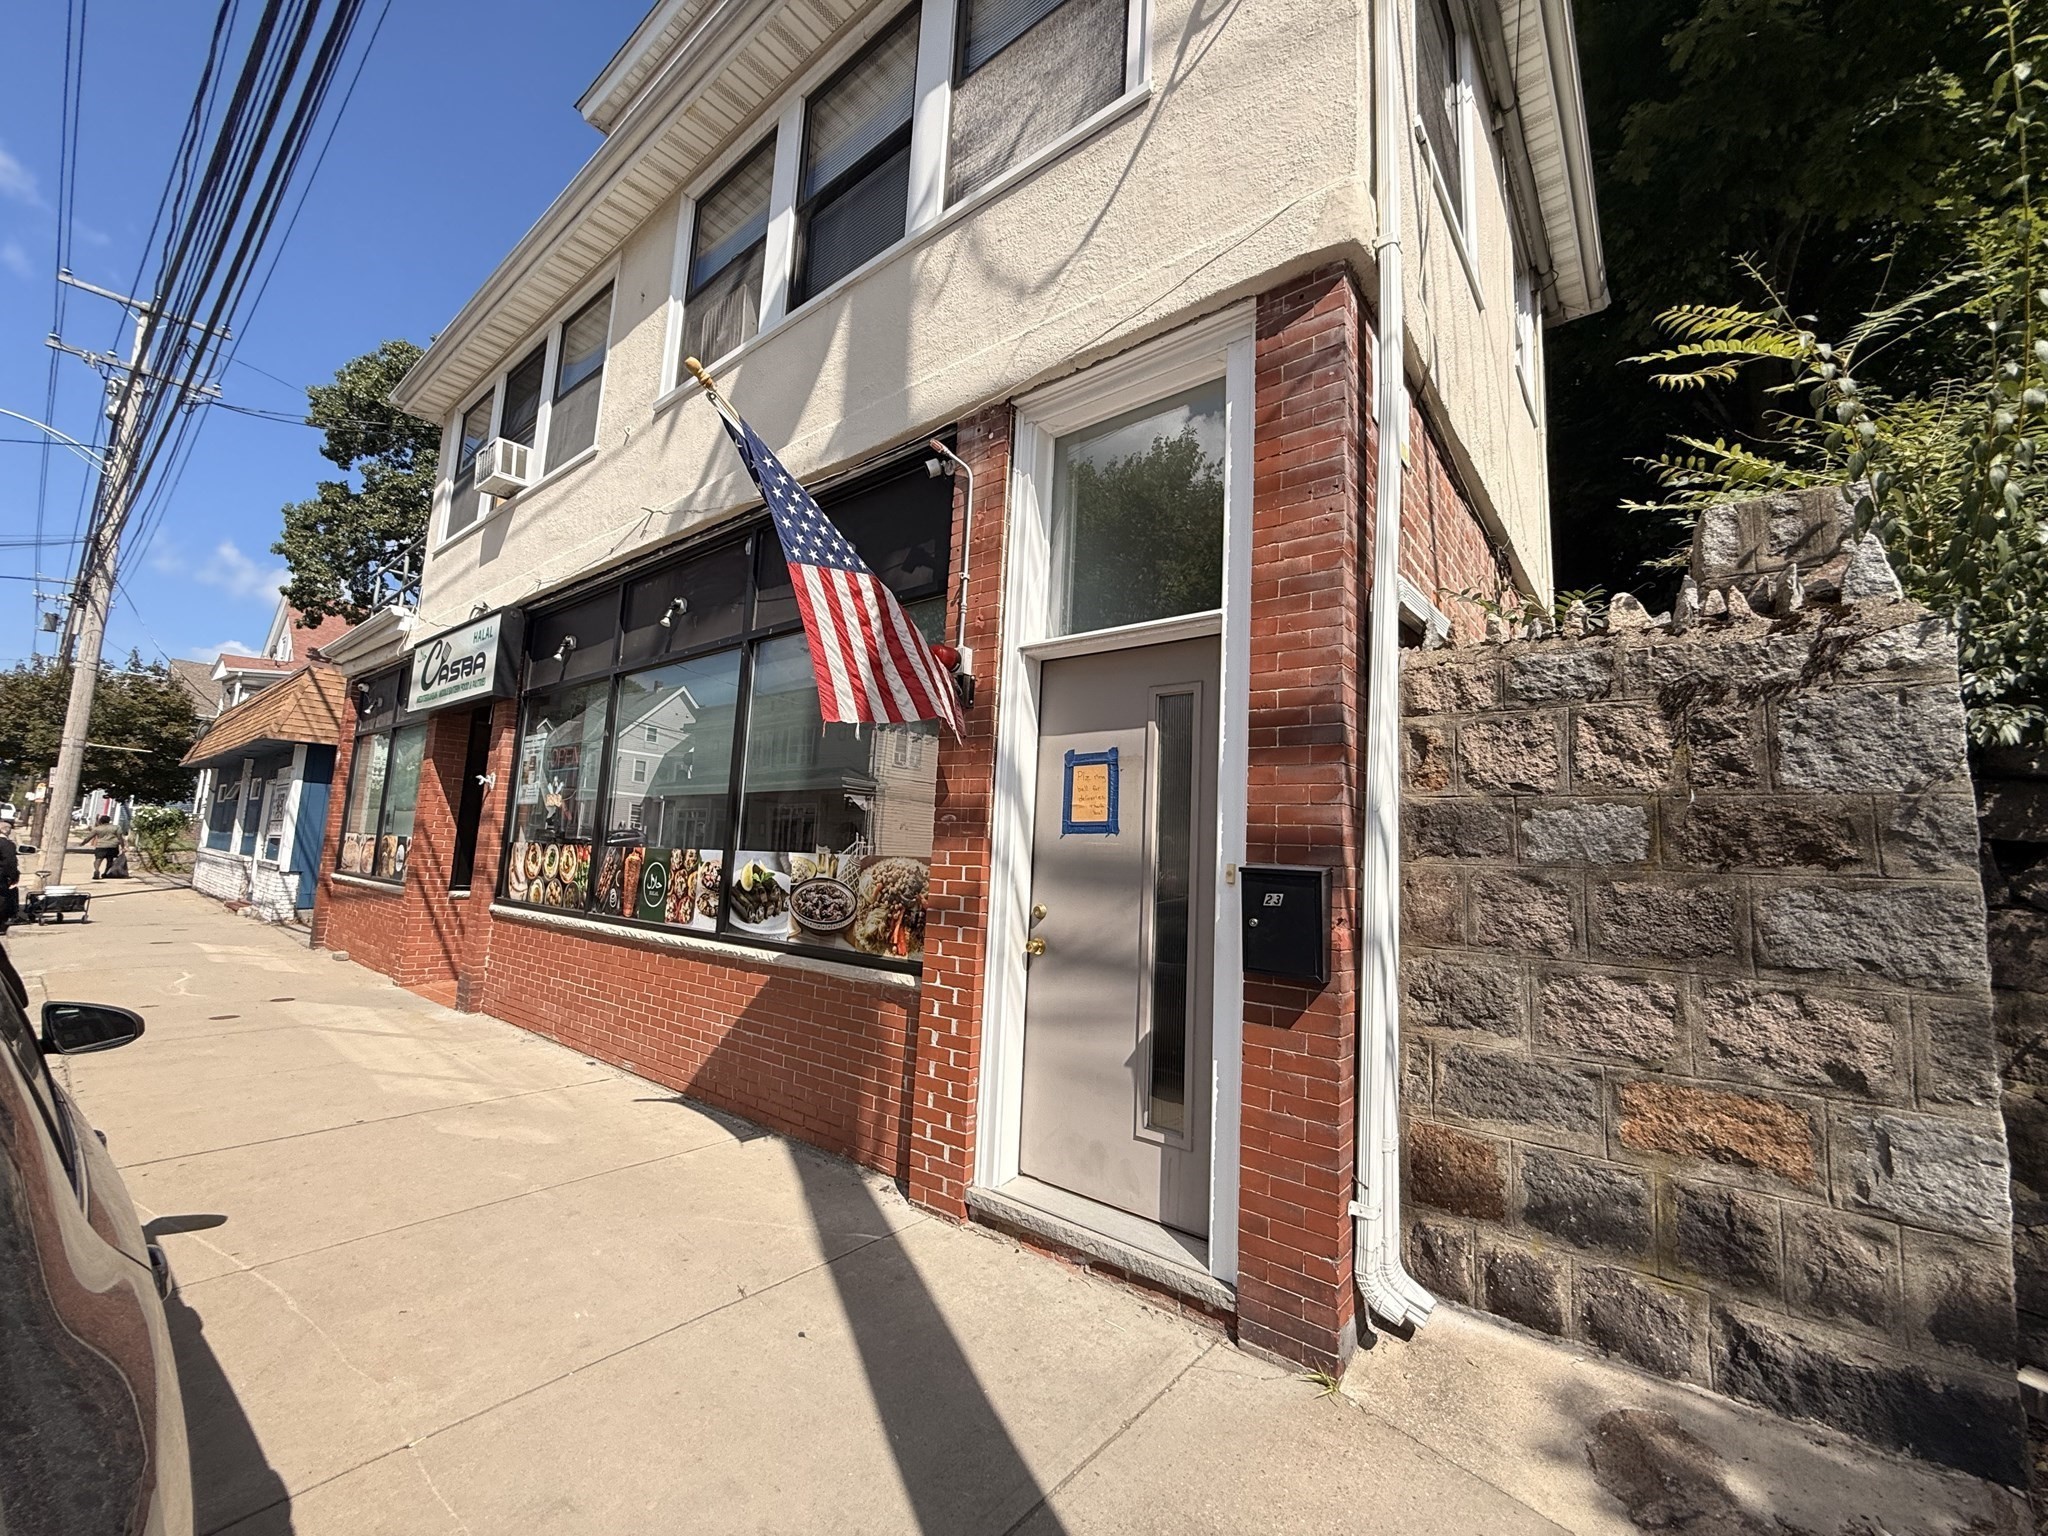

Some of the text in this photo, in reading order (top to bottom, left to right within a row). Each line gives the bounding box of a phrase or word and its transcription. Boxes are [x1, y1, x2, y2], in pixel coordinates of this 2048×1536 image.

[472, 625, 493, 644] HALAL
[551, 746, 579, 769] OPEN
[647, 873, 663, 890] حلال
[1265, 894, 1282, 905] 23
